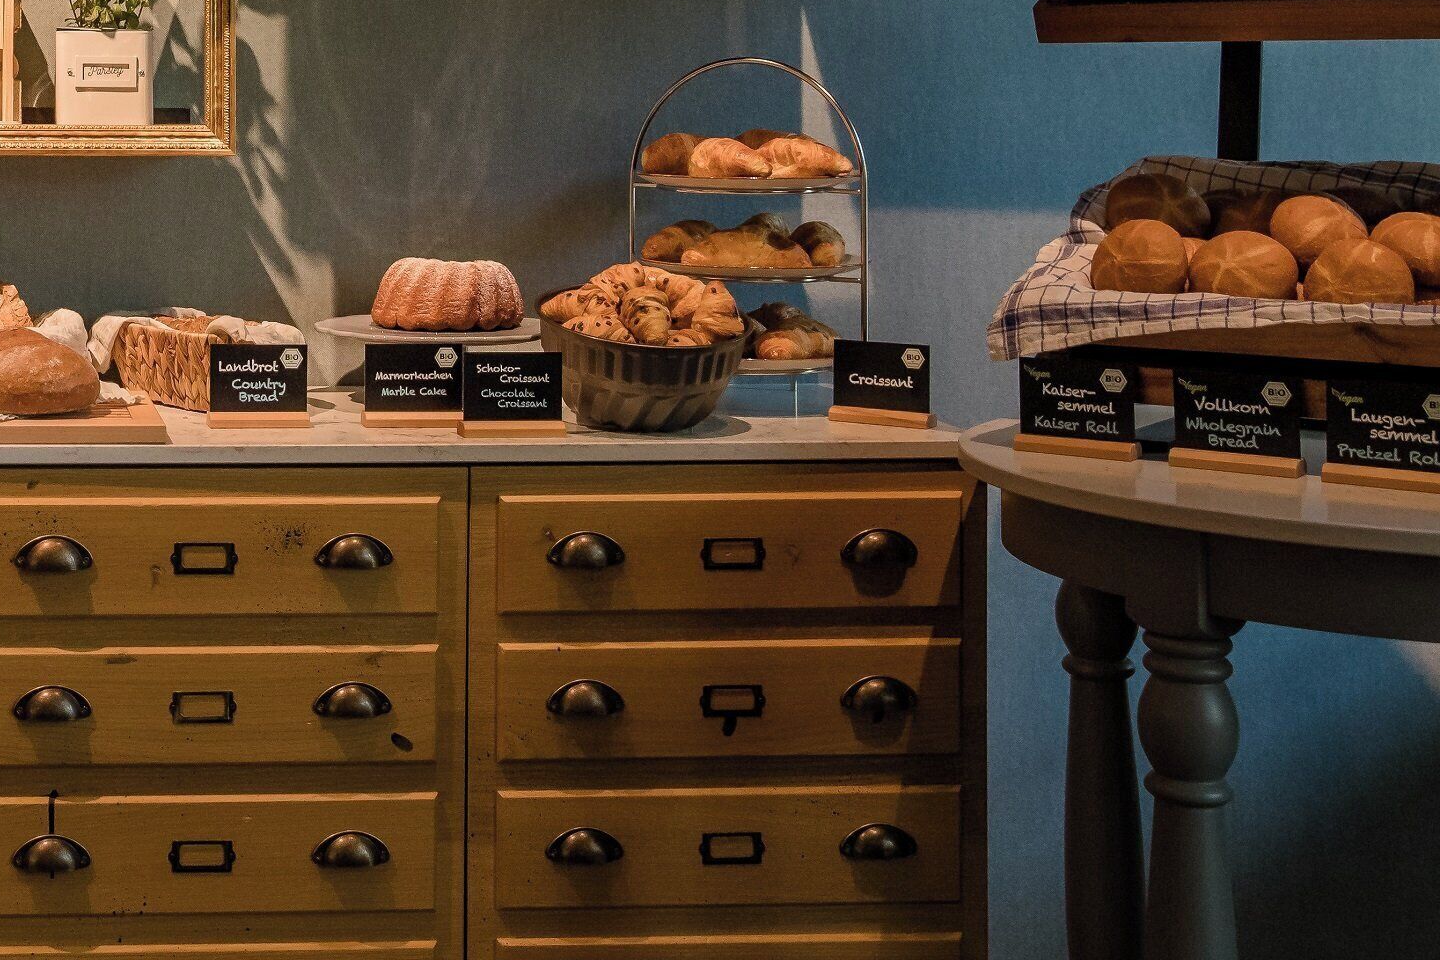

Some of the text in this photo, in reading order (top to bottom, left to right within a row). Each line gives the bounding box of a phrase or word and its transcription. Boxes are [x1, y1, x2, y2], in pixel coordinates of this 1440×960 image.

[87, 66, 124, 78] Parsley
[218, 359, 279, 373] Landbrot
[476, 363, 521, 374] Schoko-
[375, 370, 454, 381] Marmorkuchen
[499, 372, 550, 384] Croissant
[848, 373, 914, 389] Croissant
[231, 378, 286, 396] Country
[381, 385, 447, 397] Marble Cake
[481, 388, 536, 398] Chocolate
[1042, 382, 1097, 398] Kaiser-
[238, 390, 279, 402] Bread
[497, 398, 548, 408] Croissant
[1056, 401, 1116, 415] semmel
[1193, 395, 1271, 415] Vollkorn
[1034, 415, 1120, 435] Kaiser Roll
[1351, 408, 1426, 429] Laugen-
[1185, 417, 1282, 438] Wholegrain
[1207, 433, 1259, 449] Bread
[1369, 428, 1440, 445] semmel
[1337, 443, 1440, 467] Pretzel Rol
